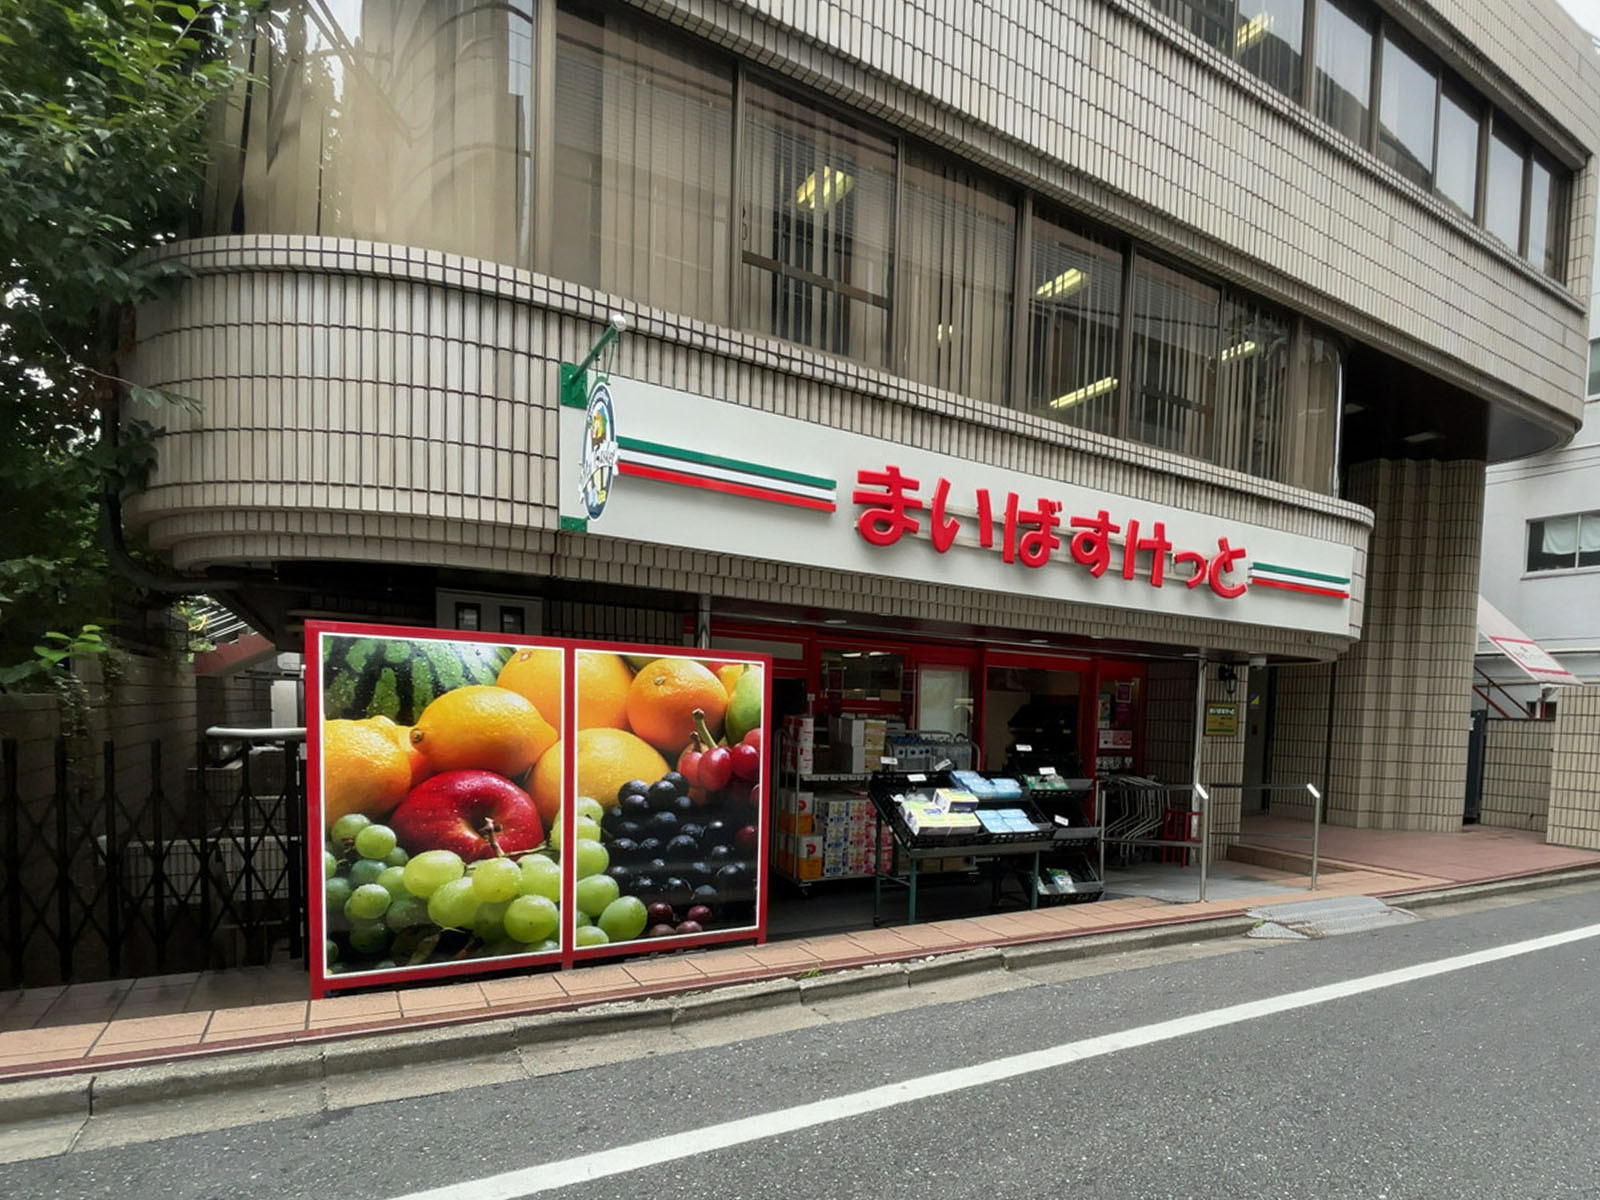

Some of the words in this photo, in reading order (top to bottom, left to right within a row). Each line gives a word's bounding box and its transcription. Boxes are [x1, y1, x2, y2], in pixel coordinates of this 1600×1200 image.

[853, 465, 1247, 599] まいばすけっと
